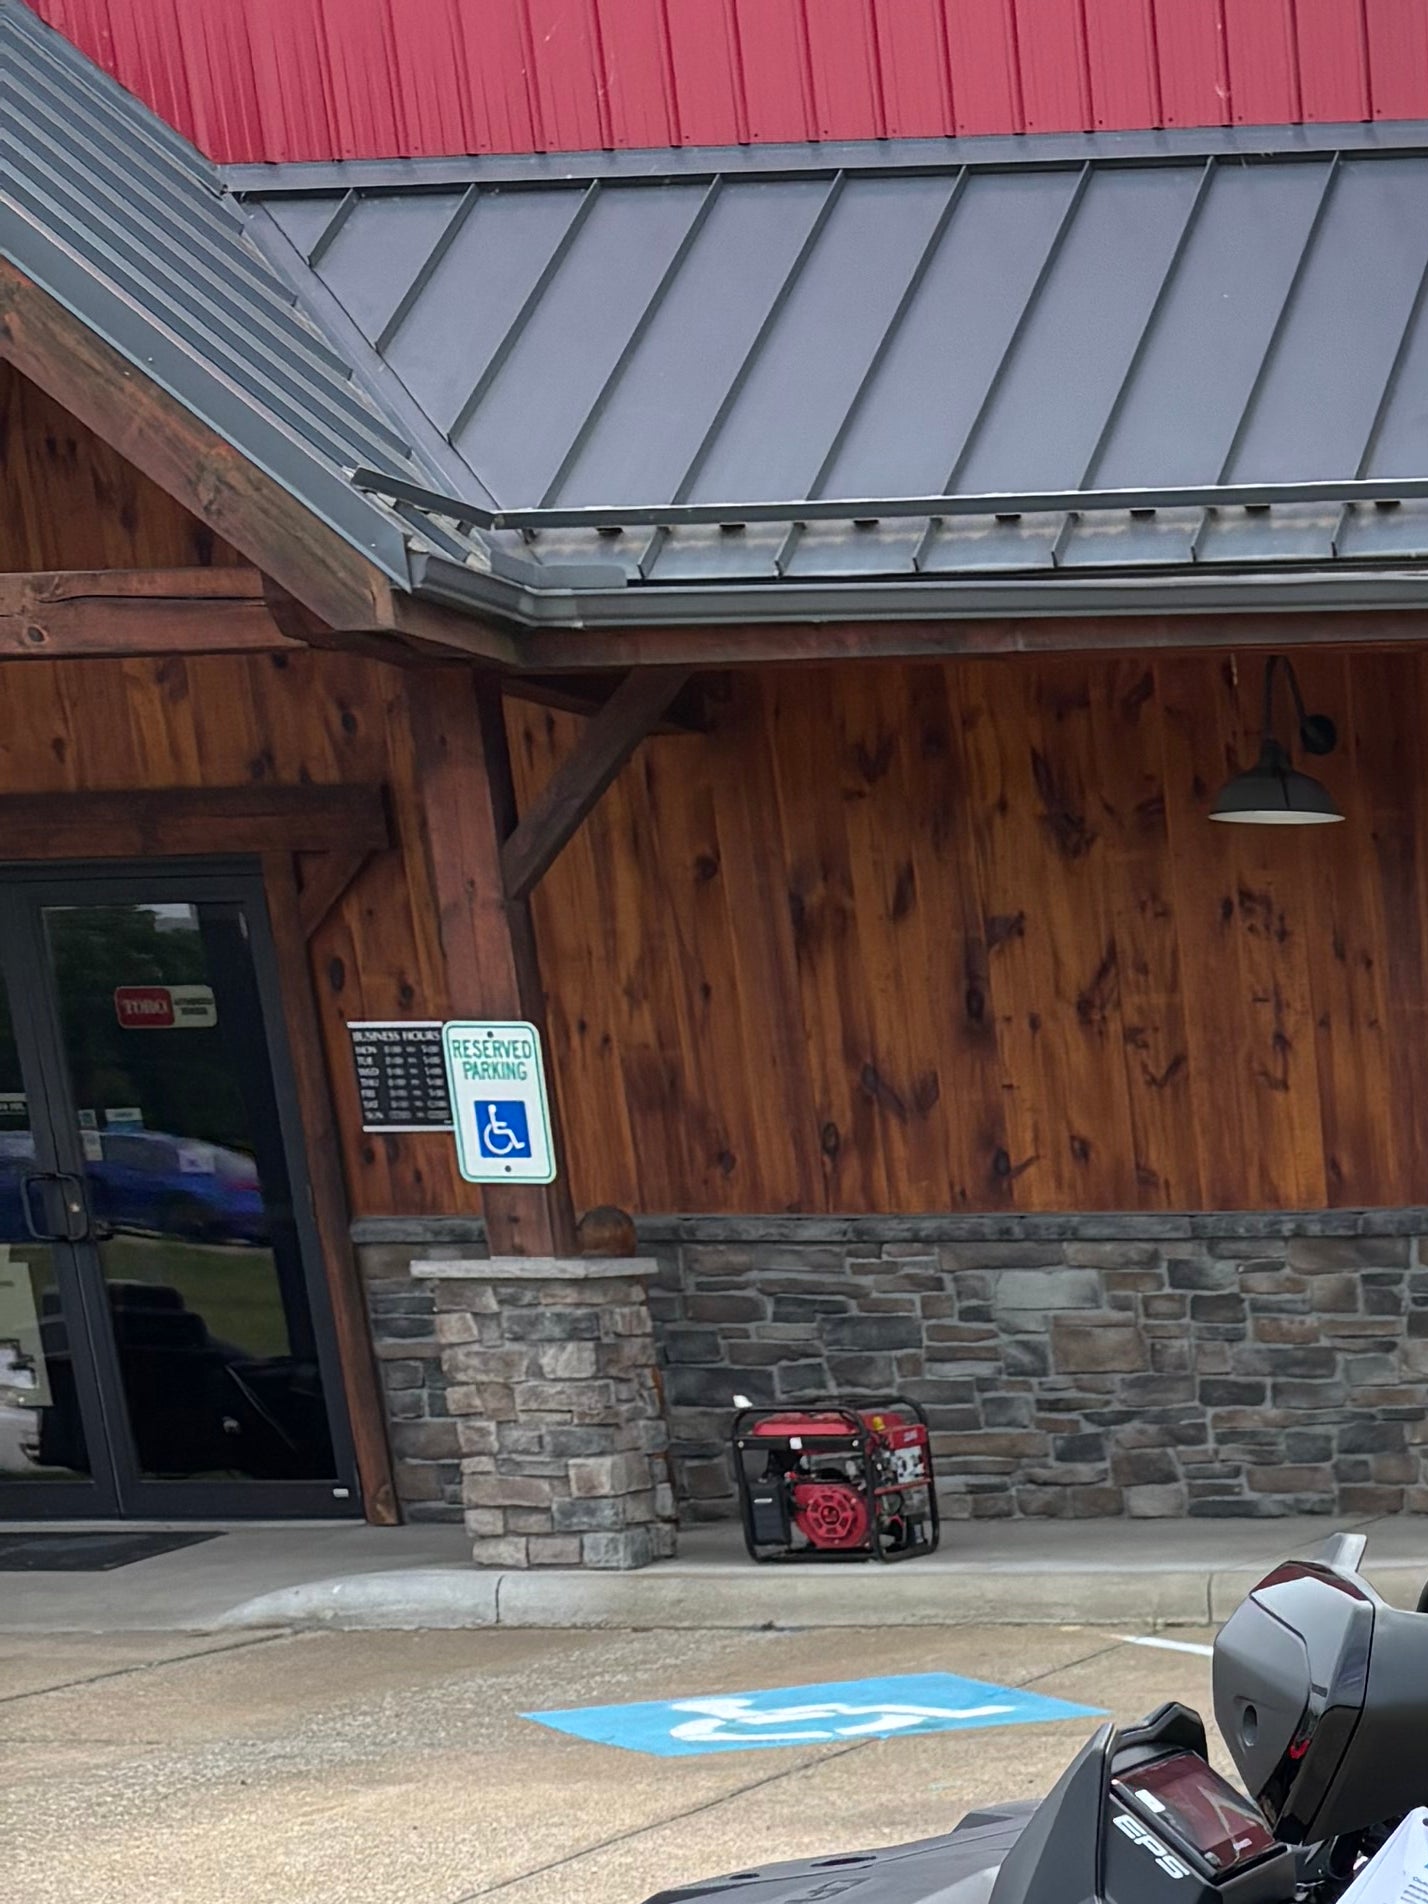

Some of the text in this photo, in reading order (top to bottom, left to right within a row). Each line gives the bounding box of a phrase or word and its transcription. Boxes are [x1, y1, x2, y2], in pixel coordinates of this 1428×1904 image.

[401, 1030, 441, 1041] HOURS
[451, 1039, 533, 1060] RESERVED
[461, 1061, 528, 1081] PARKING
[1112, 1813, 1191, 1880] EPS
